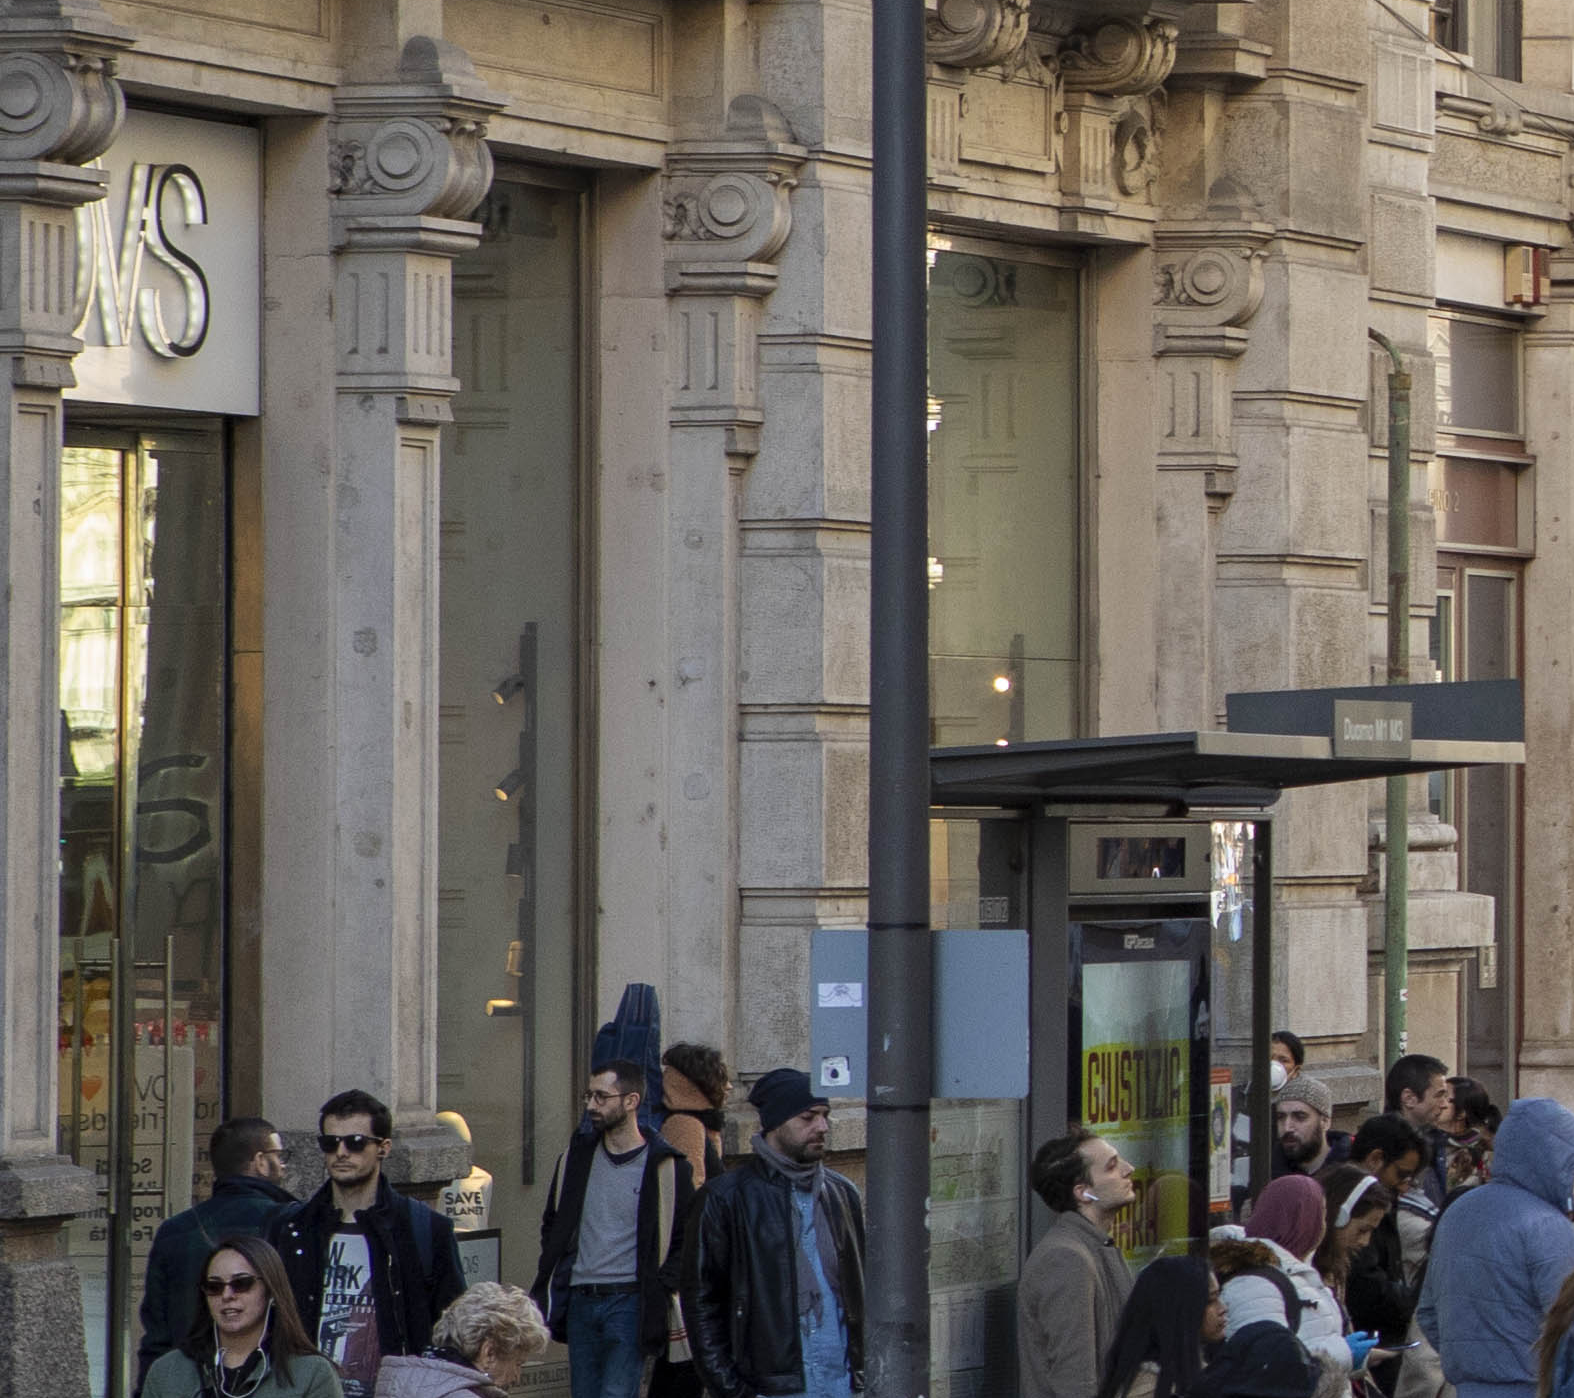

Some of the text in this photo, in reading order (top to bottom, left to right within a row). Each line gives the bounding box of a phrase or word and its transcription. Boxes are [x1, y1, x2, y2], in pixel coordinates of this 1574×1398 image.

[1087, 1047, 1181, 1124] GIUSTIZIA
[445, 1191, 482, 1205] SAVE
[446, 1206, 485, 1216] PLANET
